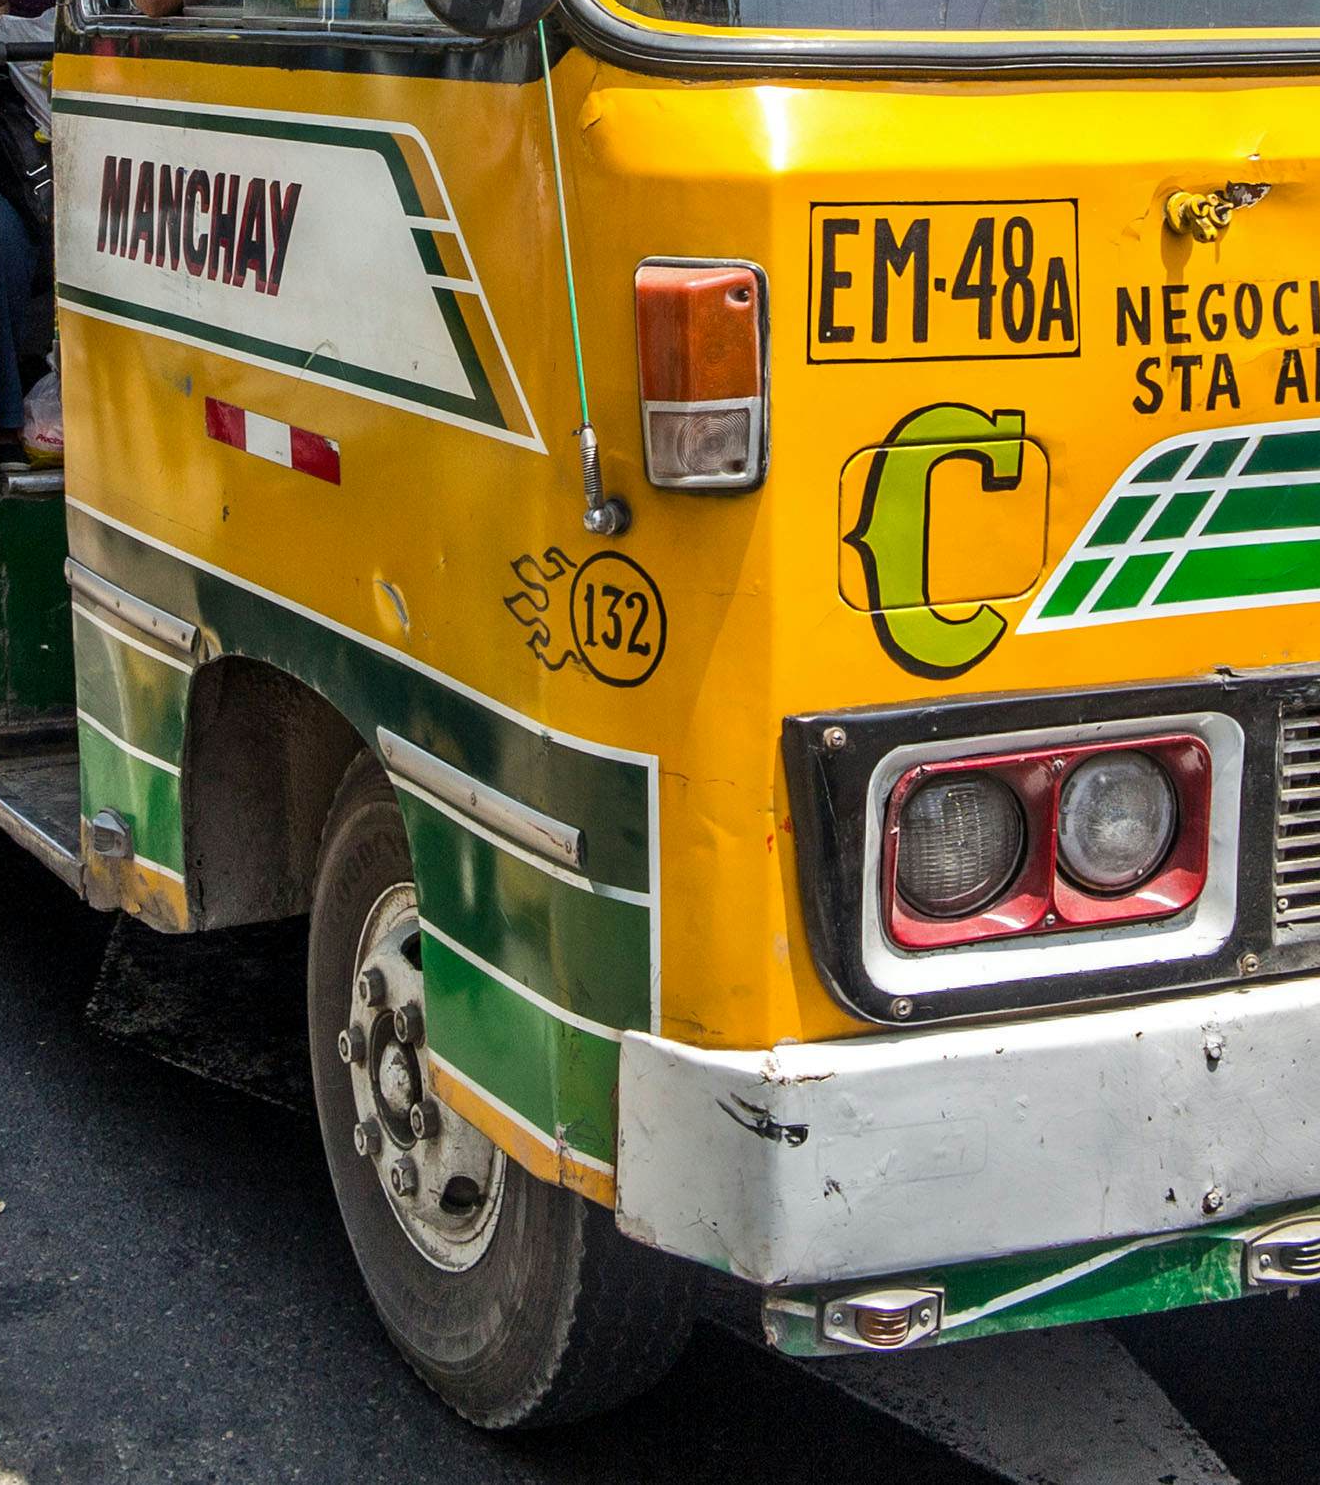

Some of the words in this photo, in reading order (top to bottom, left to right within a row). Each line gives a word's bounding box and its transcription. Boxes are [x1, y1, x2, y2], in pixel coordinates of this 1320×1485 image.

[97, 155, 302, 297] MANCHAY
[1132, 353, 1239, 414] STA
[843, 402, 1025, 679] C
[583, 583, 651, 657] 132
